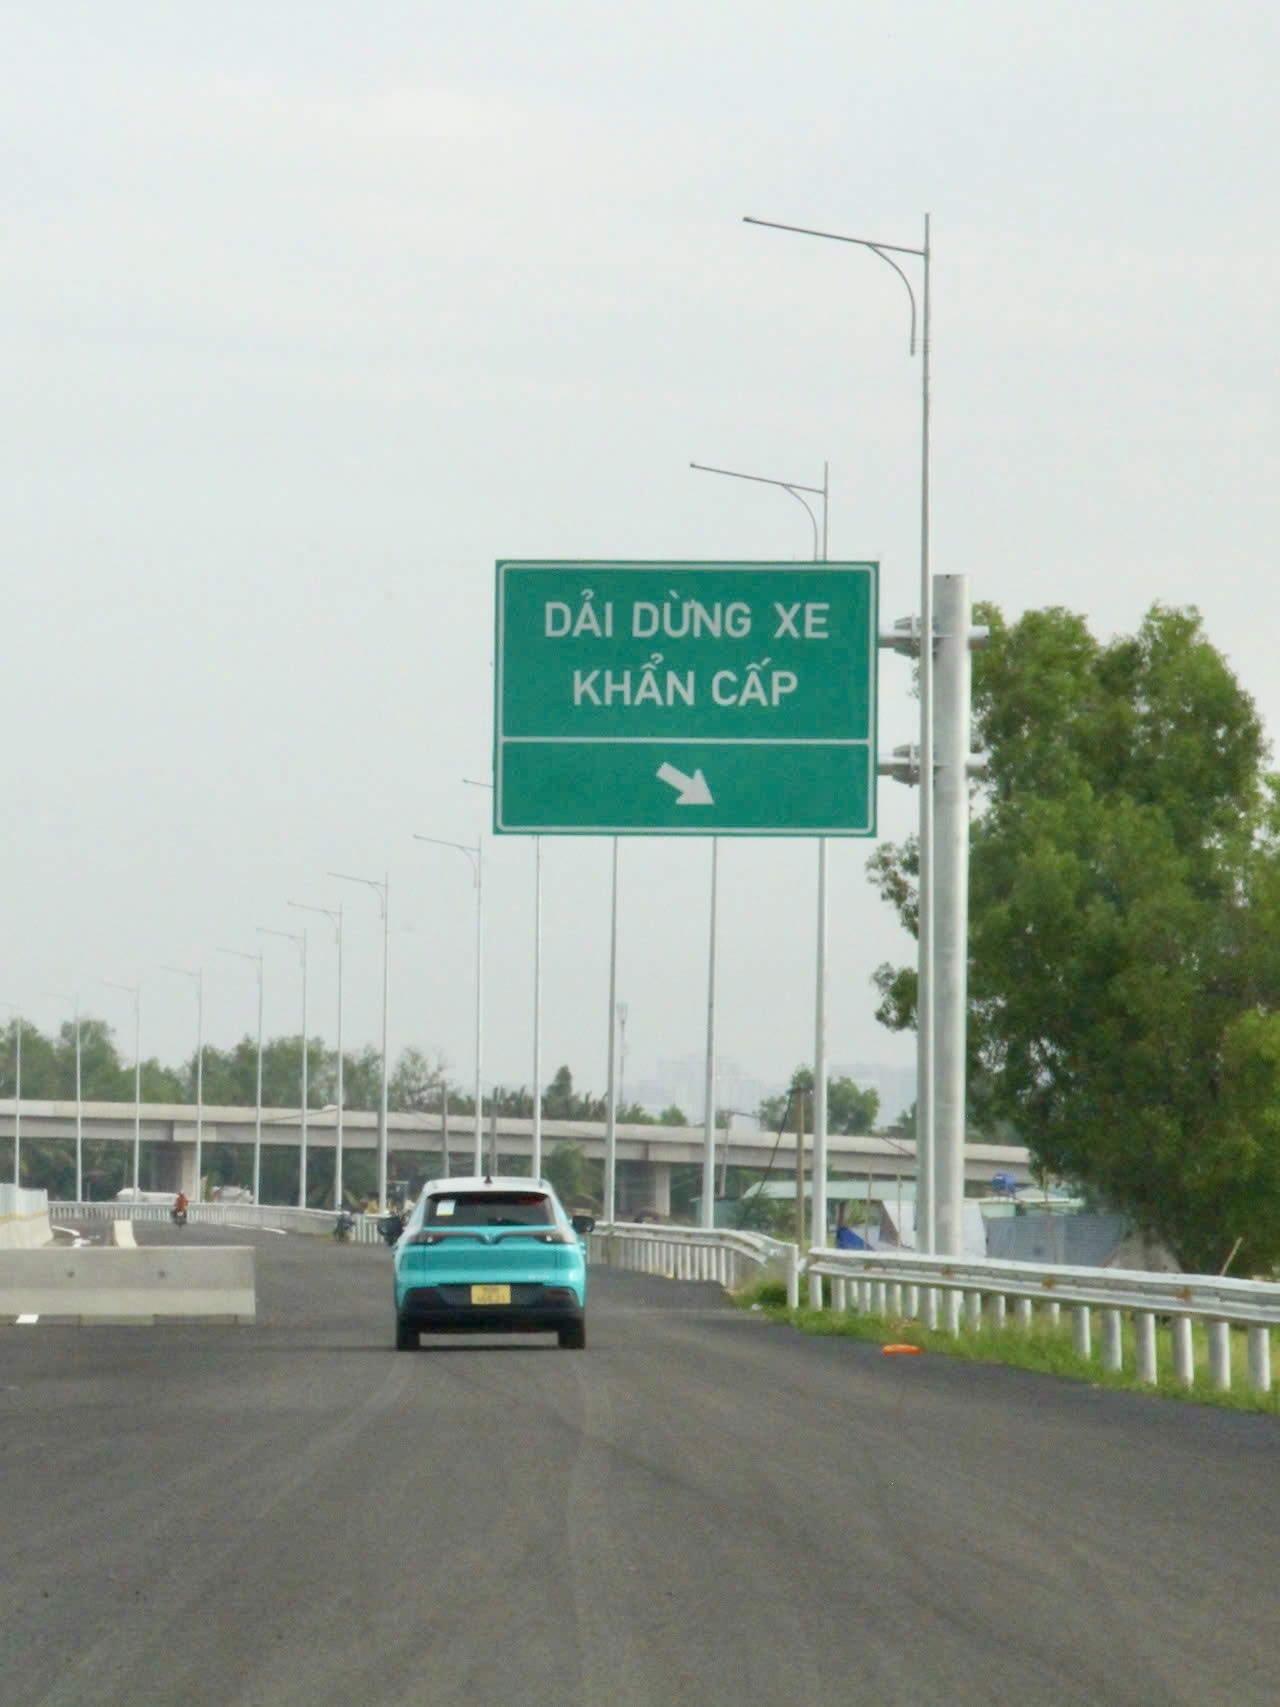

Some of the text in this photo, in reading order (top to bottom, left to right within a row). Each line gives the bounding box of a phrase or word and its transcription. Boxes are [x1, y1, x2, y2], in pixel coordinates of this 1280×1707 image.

[544, 589, 830, 639] DẢI DỪNG XE
[573, 653, 799, 706] KHẨN CẤP
